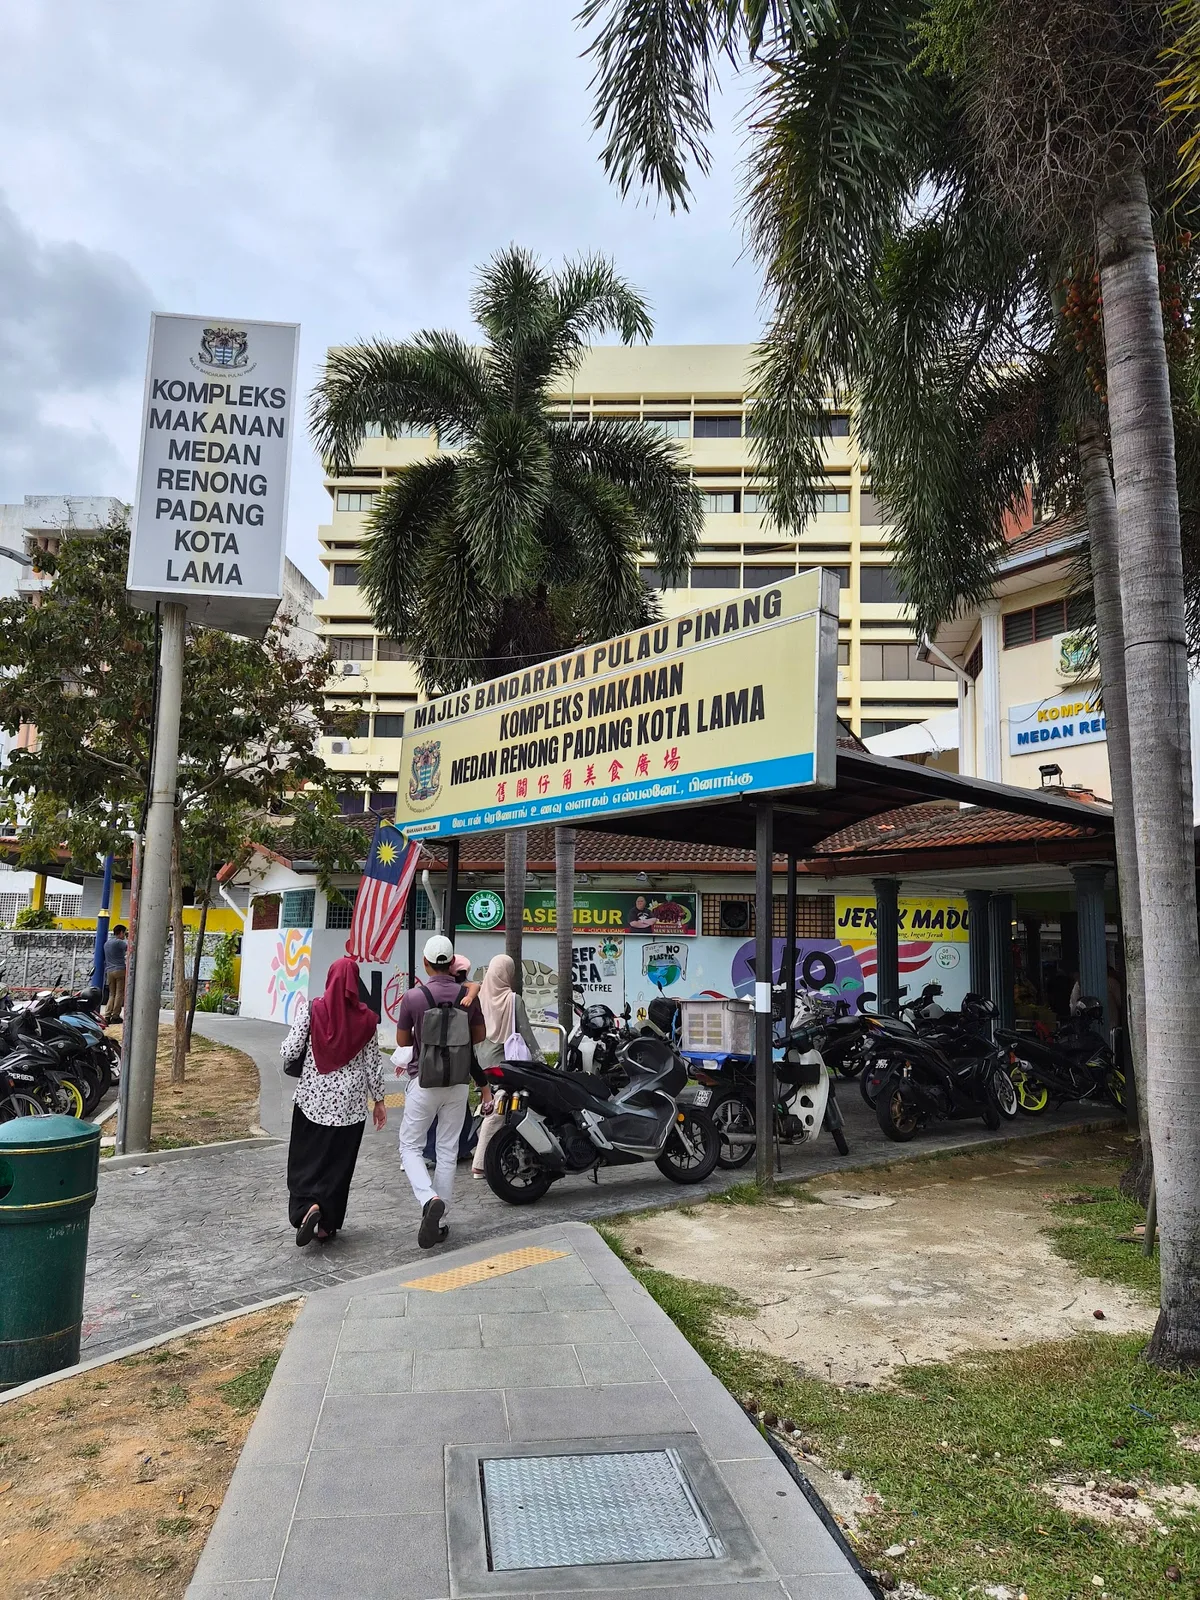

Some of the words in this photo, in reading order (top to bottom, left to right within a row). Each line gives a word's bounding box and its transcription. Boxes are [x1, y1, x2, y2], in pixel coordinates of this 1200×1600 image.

[152, 379, 286, 409] KOMPLEKS
[149, 408, 285, 438] MAKANAN
[168, 439, 261, 466] MEDAN
[157, 468, 267, 496] RENONG
[155, 498, 264, 526] PADANG
[174, 529, 240, 555] KOTA
[166, 559, 243, 585] LAMA
[413, 693, 470, 729] MAJLIS
[474, 654, 586, 711] BANDARAYA
[593, 625, 669, 674] PULAU
[676, 589, 782, 648] PINANG
[500, 691, 583, 741] KOMPLEKS
[587, 662, 684, 719] MAKANAN
[450, 749, 498, 786] MEDAN
[500, 735, 559, 775] RENONG
[562, 716, 633, 763] PADANG
[637, 702, 690, 746] KOTA
[697, 684, 765, 734] LAMA
[1017, 724, 1074, 745] MEDAN
[838, 908, 908, 929] JERK
[649, 953, 675, 962] PLASTIC
[665, 945, 680, 954] NO
[938, 952, 956, 961] GREEN
[594, 984, 613, 993] FREE
